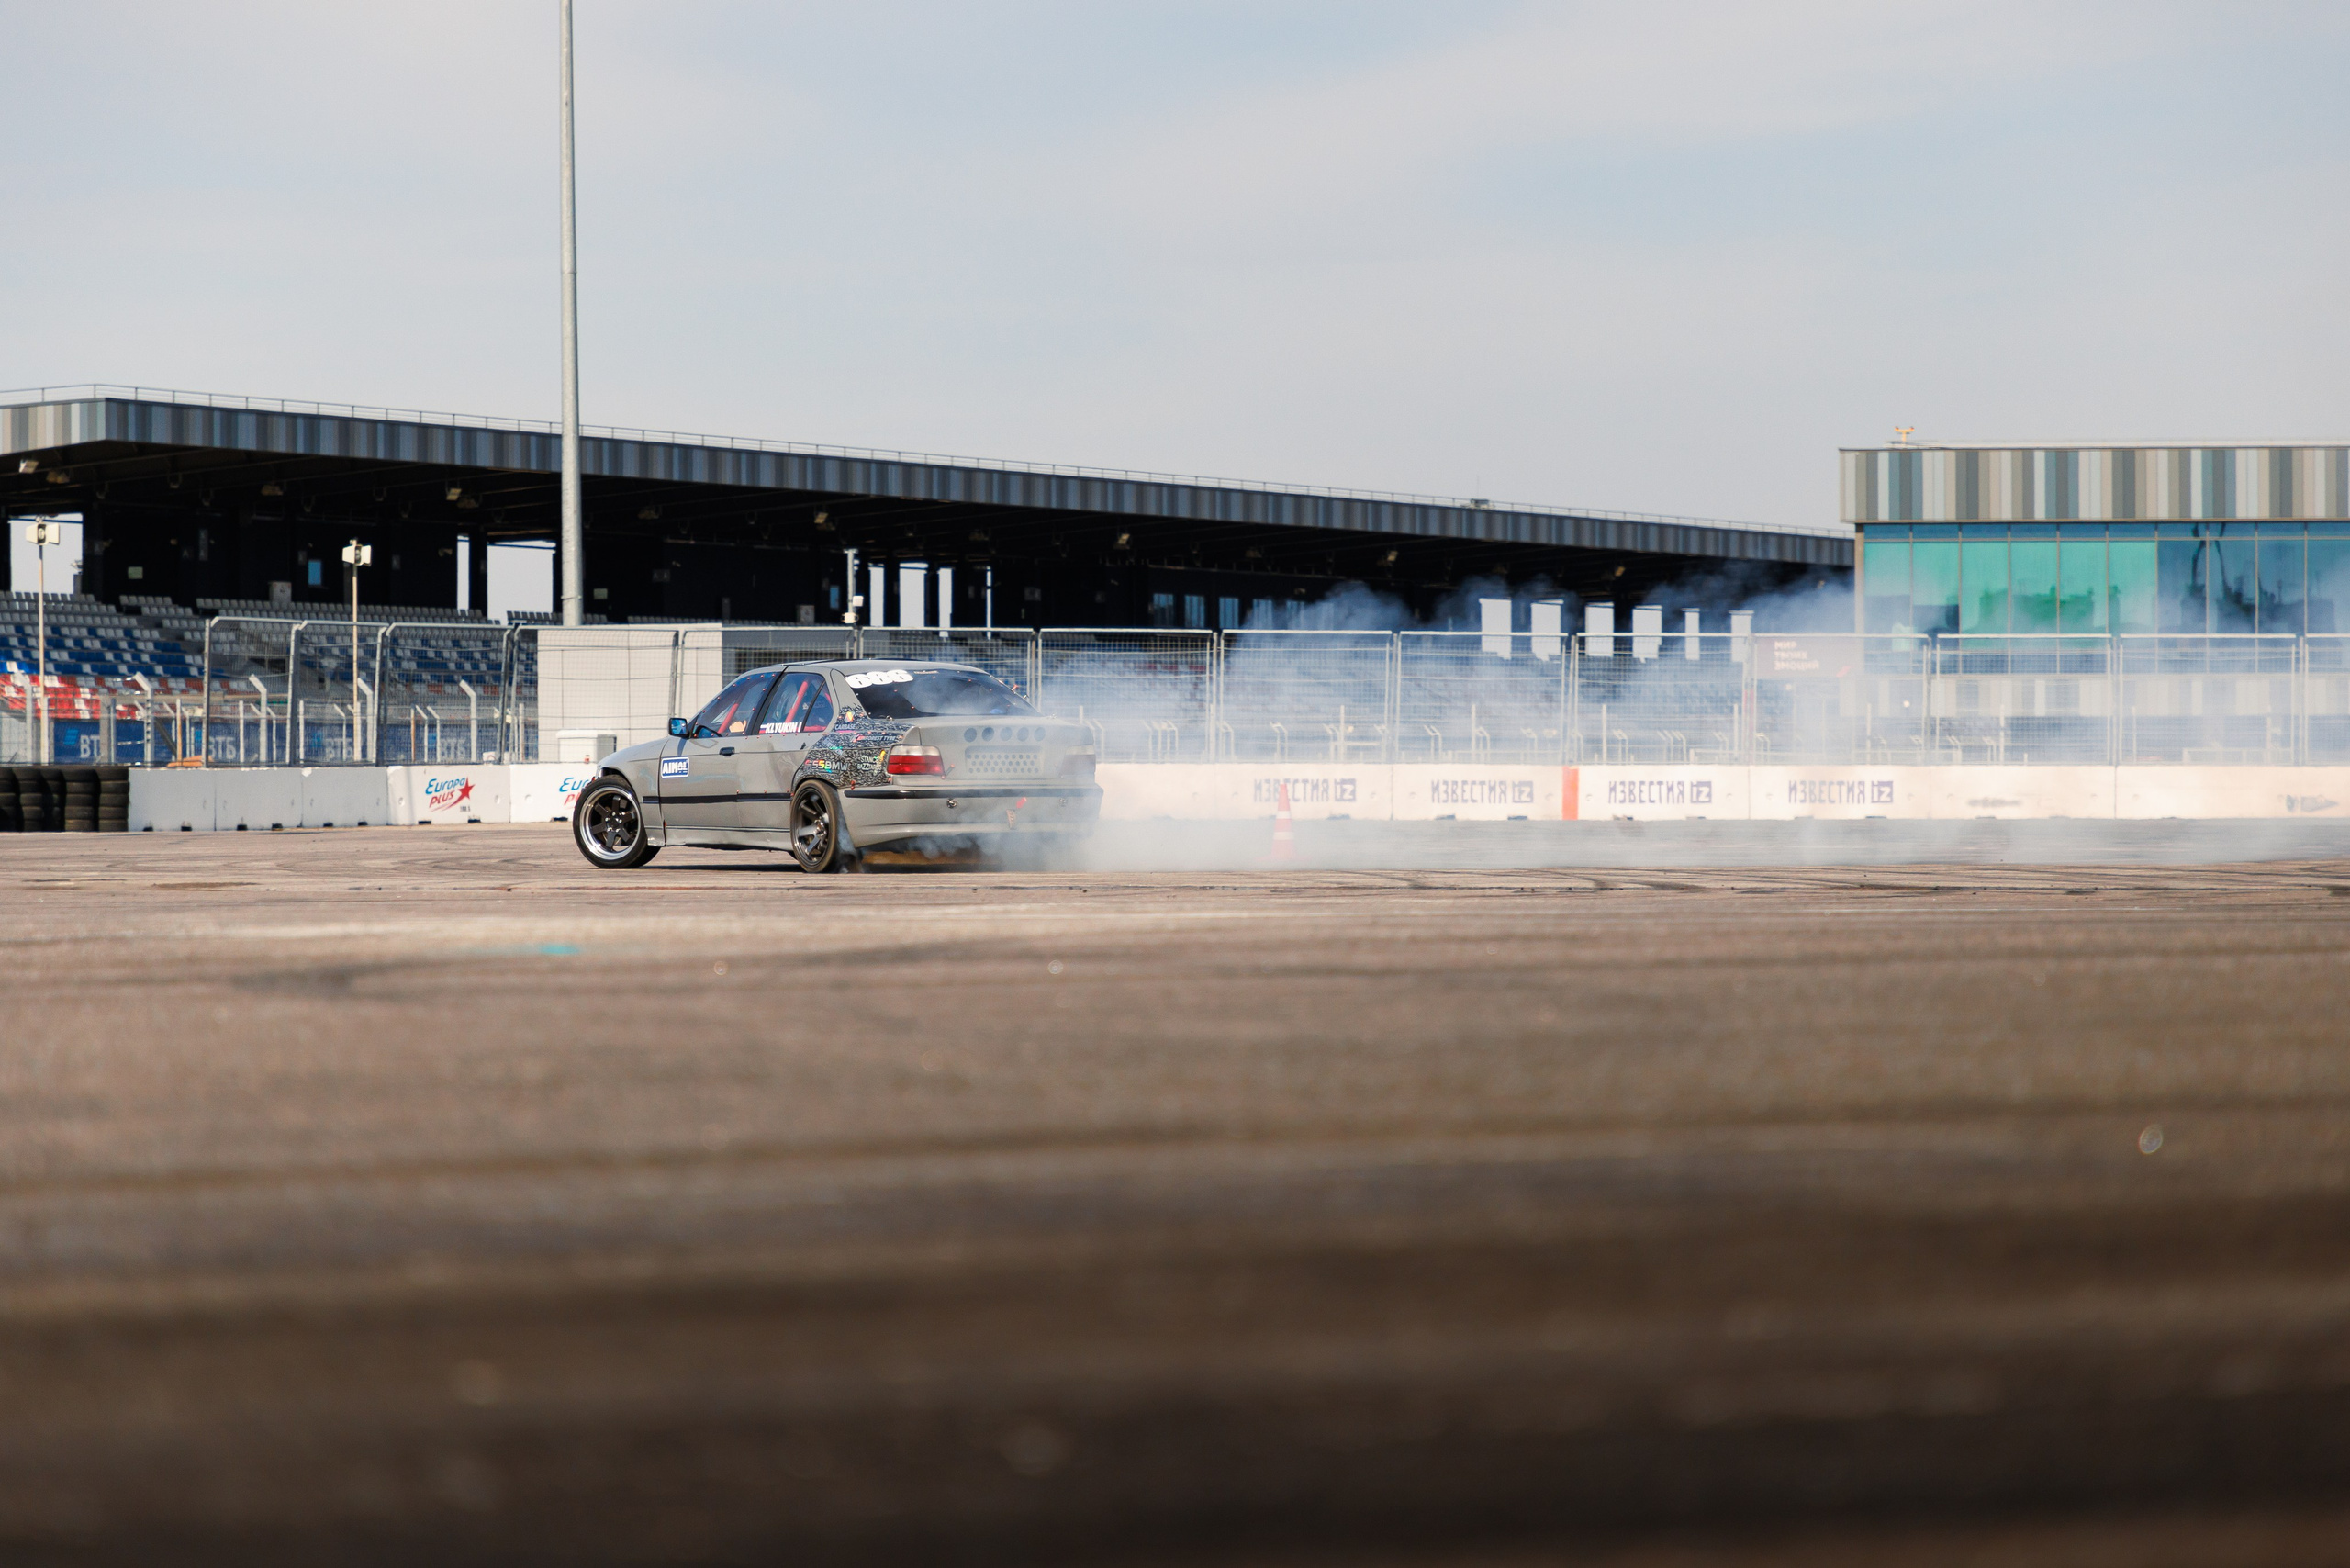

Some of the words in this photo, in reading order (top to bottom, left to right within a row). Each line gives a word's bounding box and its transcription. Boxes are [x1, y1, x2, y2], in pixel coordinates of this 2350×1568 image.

[765, 722, 798, 734] KLYUKIN
[80, 734, 101, 759] ВТ
[424, 778, 466, 795] Europa
[1430, 779, 1506, 804] ИЗВЕСТИЯ
[1607, 780, 1684, 804] ИЗВЕСТИЯ
[1787, 780, 1865, 804] ИЗВЕСТИЯ
